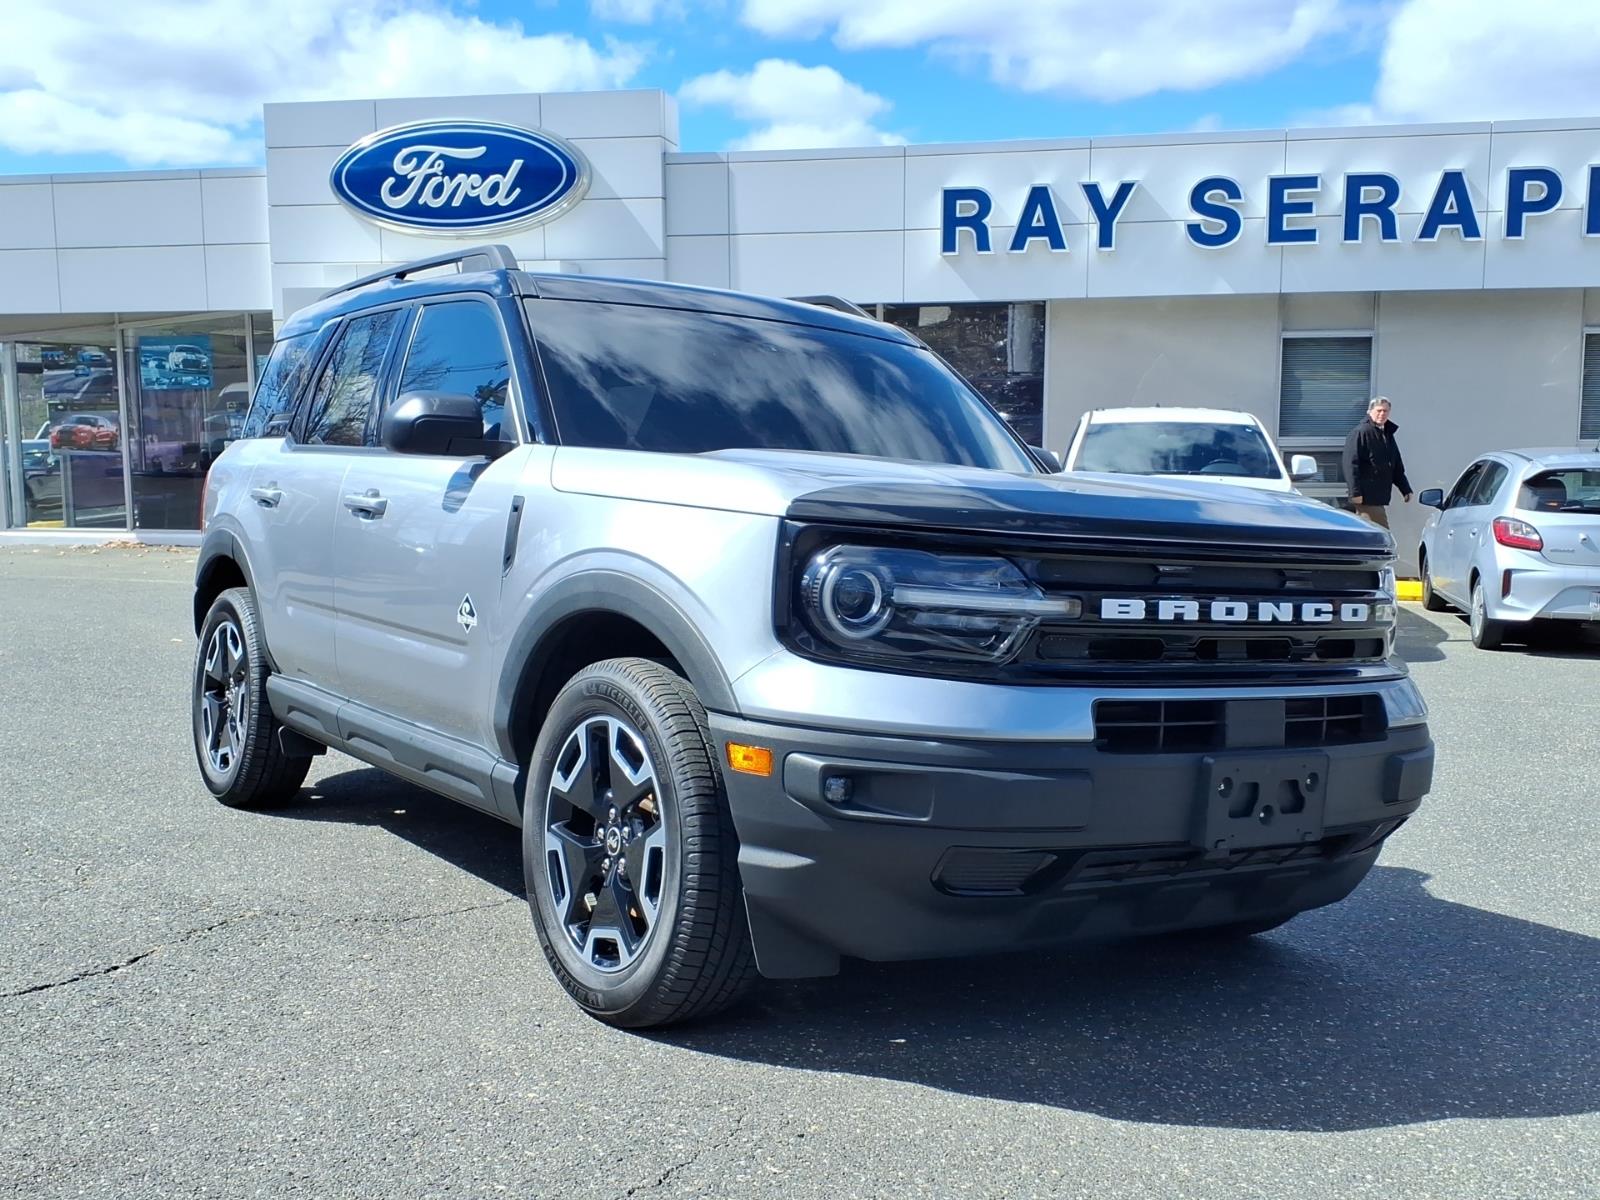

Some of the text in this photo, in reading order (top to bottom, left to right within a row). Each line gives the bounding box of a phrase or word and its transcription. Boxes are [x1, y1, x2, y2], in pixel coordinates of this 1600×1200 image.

[380, 145, 524, 208] Ford
[940, 179, 1141, 256] RAY
[1100, 598, 1368, 622] BRONCO
[597, 682, 648, 731] MICHELIN
